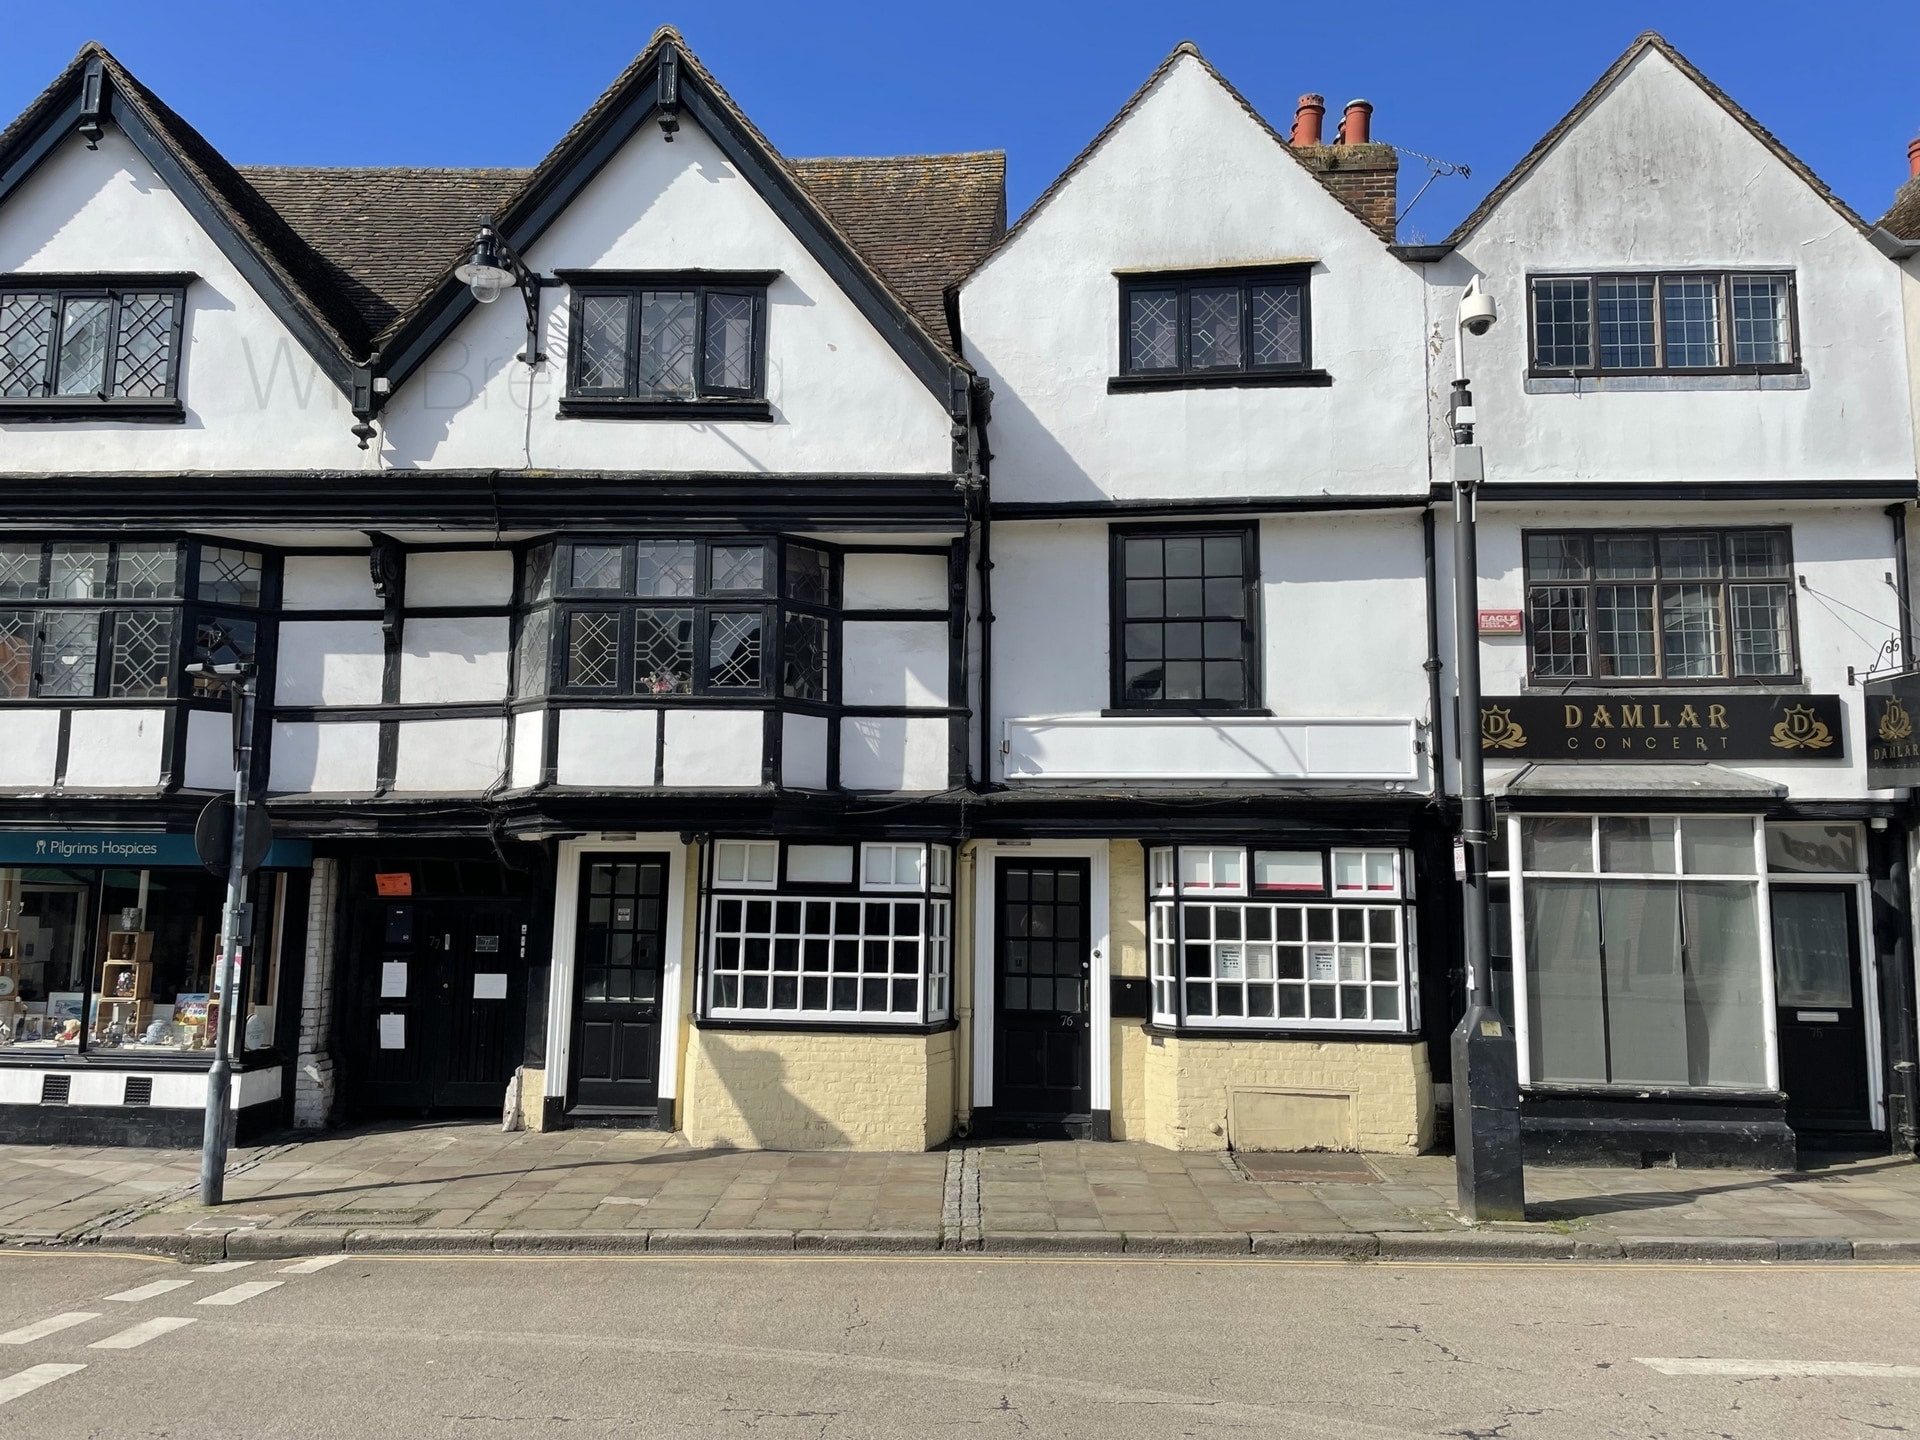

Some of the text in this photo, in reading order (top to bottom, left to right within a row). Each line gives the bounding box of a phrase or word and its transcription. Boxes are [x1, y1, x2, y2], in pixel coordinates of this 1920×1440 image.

[1481, 614, 1517, 623] EAGLE
[1564, 704, 1729, 729] DAMLAR
[1890, 705, 1899, 724] D
[1489, 714, 1505, 734] D
[1793, 714, 1808, 734] D
[1567, 737, 1728, 750] CONCERT
[1873, 743, 1920, 761] DAMLAR
[50, 840, 157, 858] Pilgrims Hospices
[429, 935, 441, 949] 77
[1060, 1015, 1074, 1026] 76
[1809, 1026, 1824, 1040] 75
